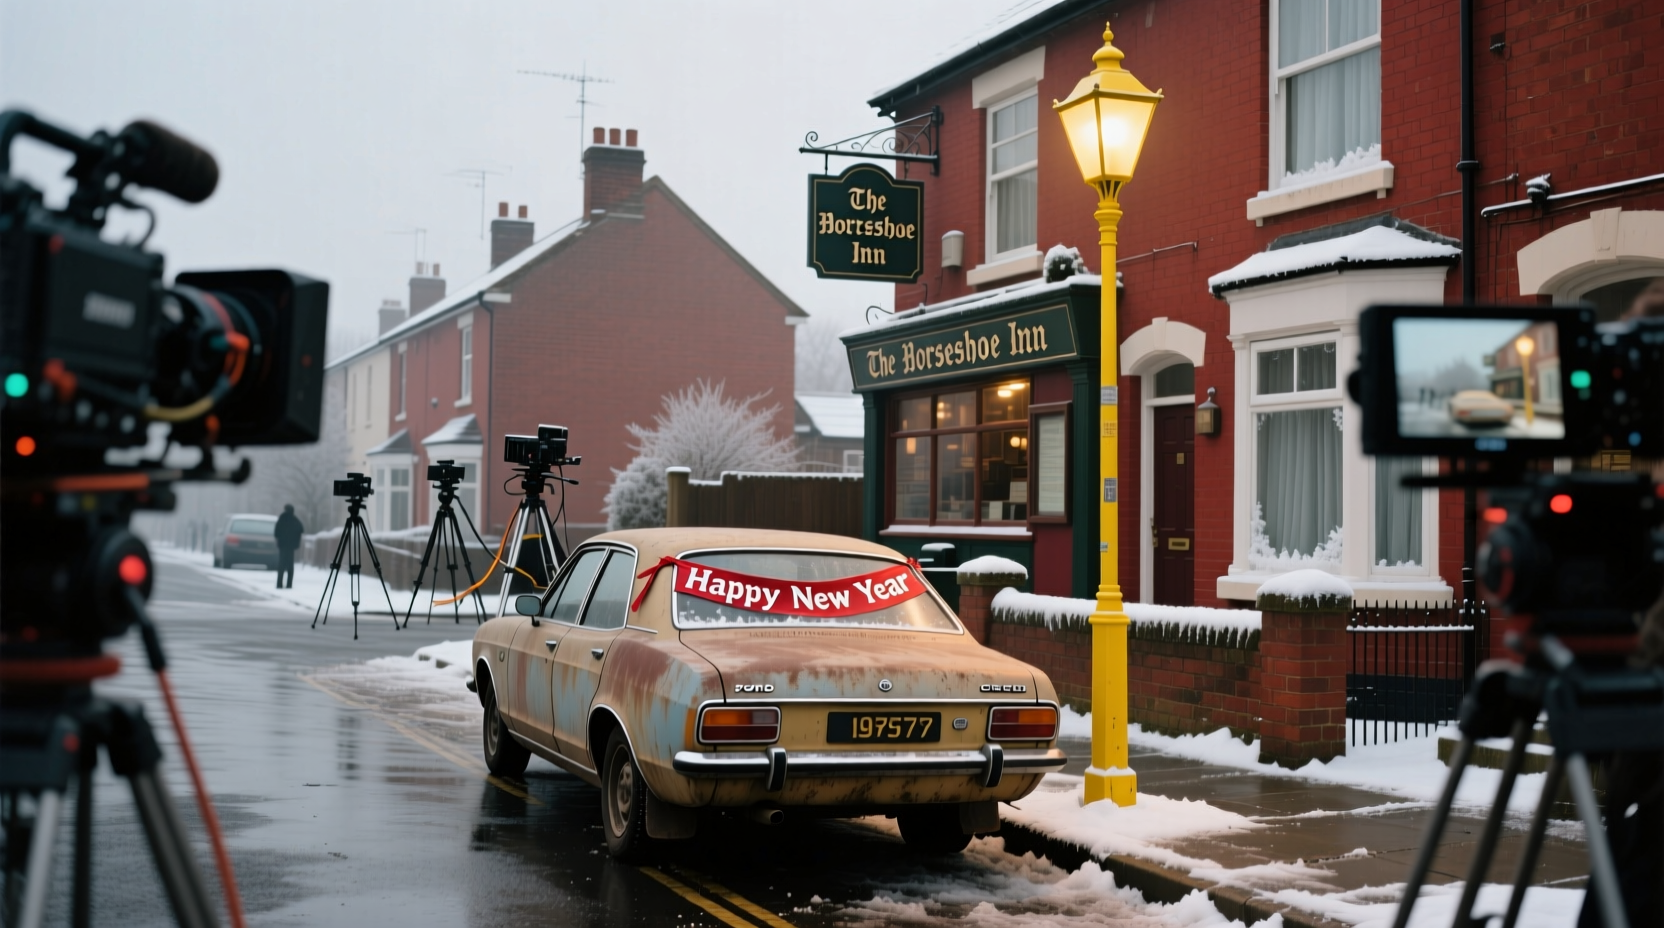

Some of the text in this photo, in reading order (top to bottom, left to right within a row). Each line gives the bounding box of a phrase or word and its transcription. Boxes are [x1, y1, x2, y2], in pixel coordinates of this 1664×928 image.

[848, 187, 886, 214] The
[852, 242, 886, 265] Inn
[867, 321, 1048, 378] The Horseshoe Inn
[685, 567, 908, 611] Happy New Year
[852, 716, 934, 739] 197577
